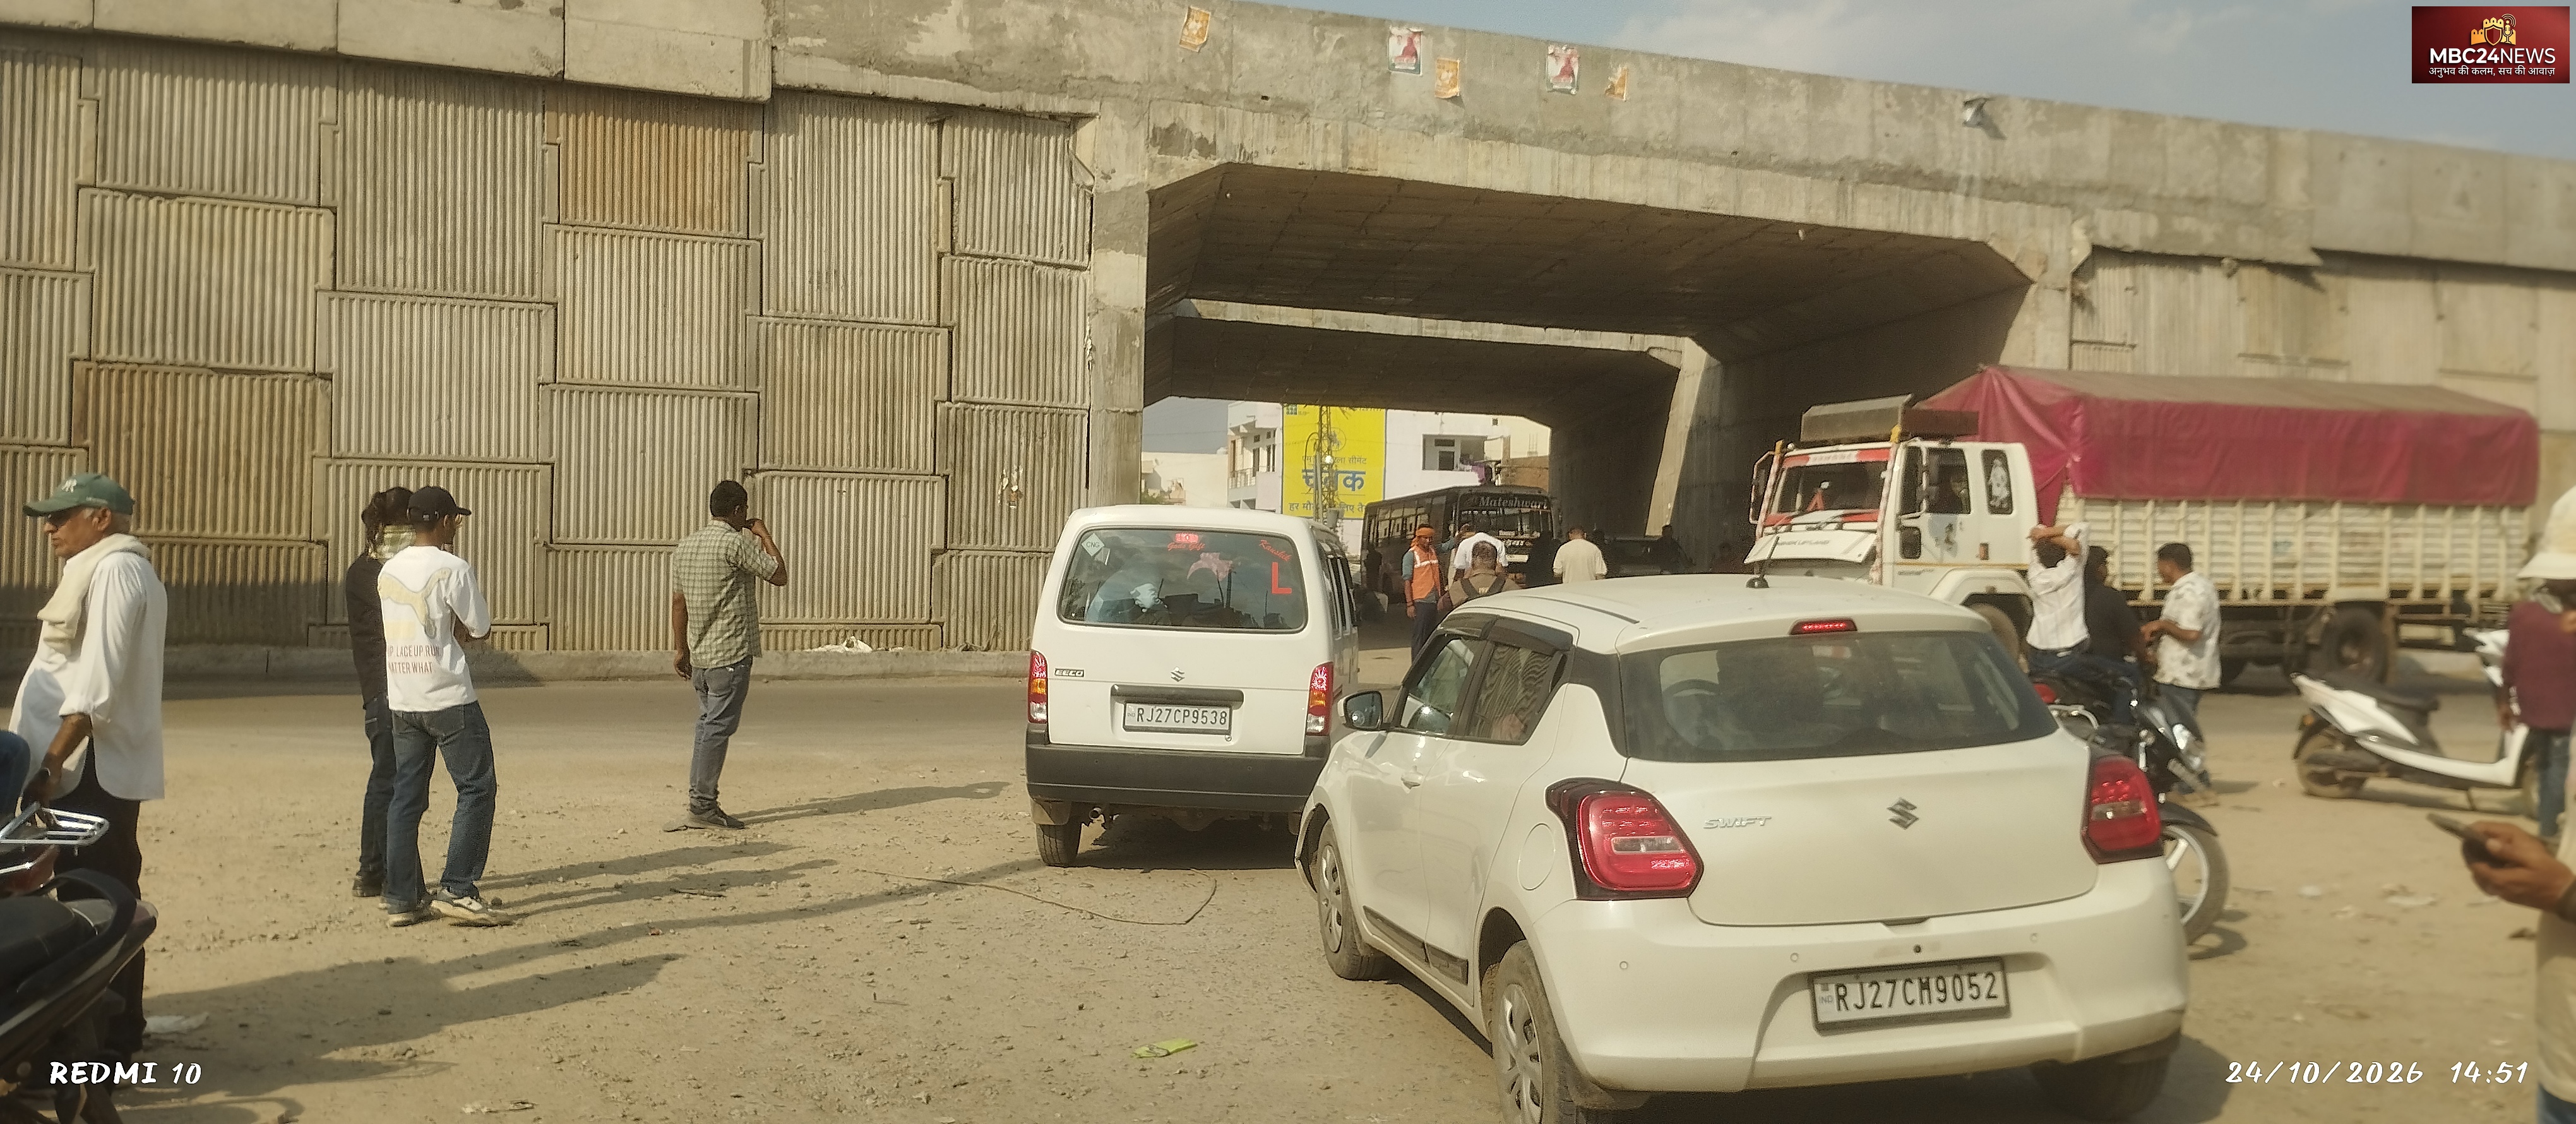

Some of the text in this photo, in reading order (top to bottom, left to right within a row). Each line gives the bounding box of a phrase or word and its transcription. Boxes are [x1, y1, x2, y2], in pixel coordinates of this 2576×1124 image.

[1272, 561, 1292, 594] L
[1136, 707, 1227, 726] RJ27CP9538
[1703, 816, 1772, 829] SWIFT
